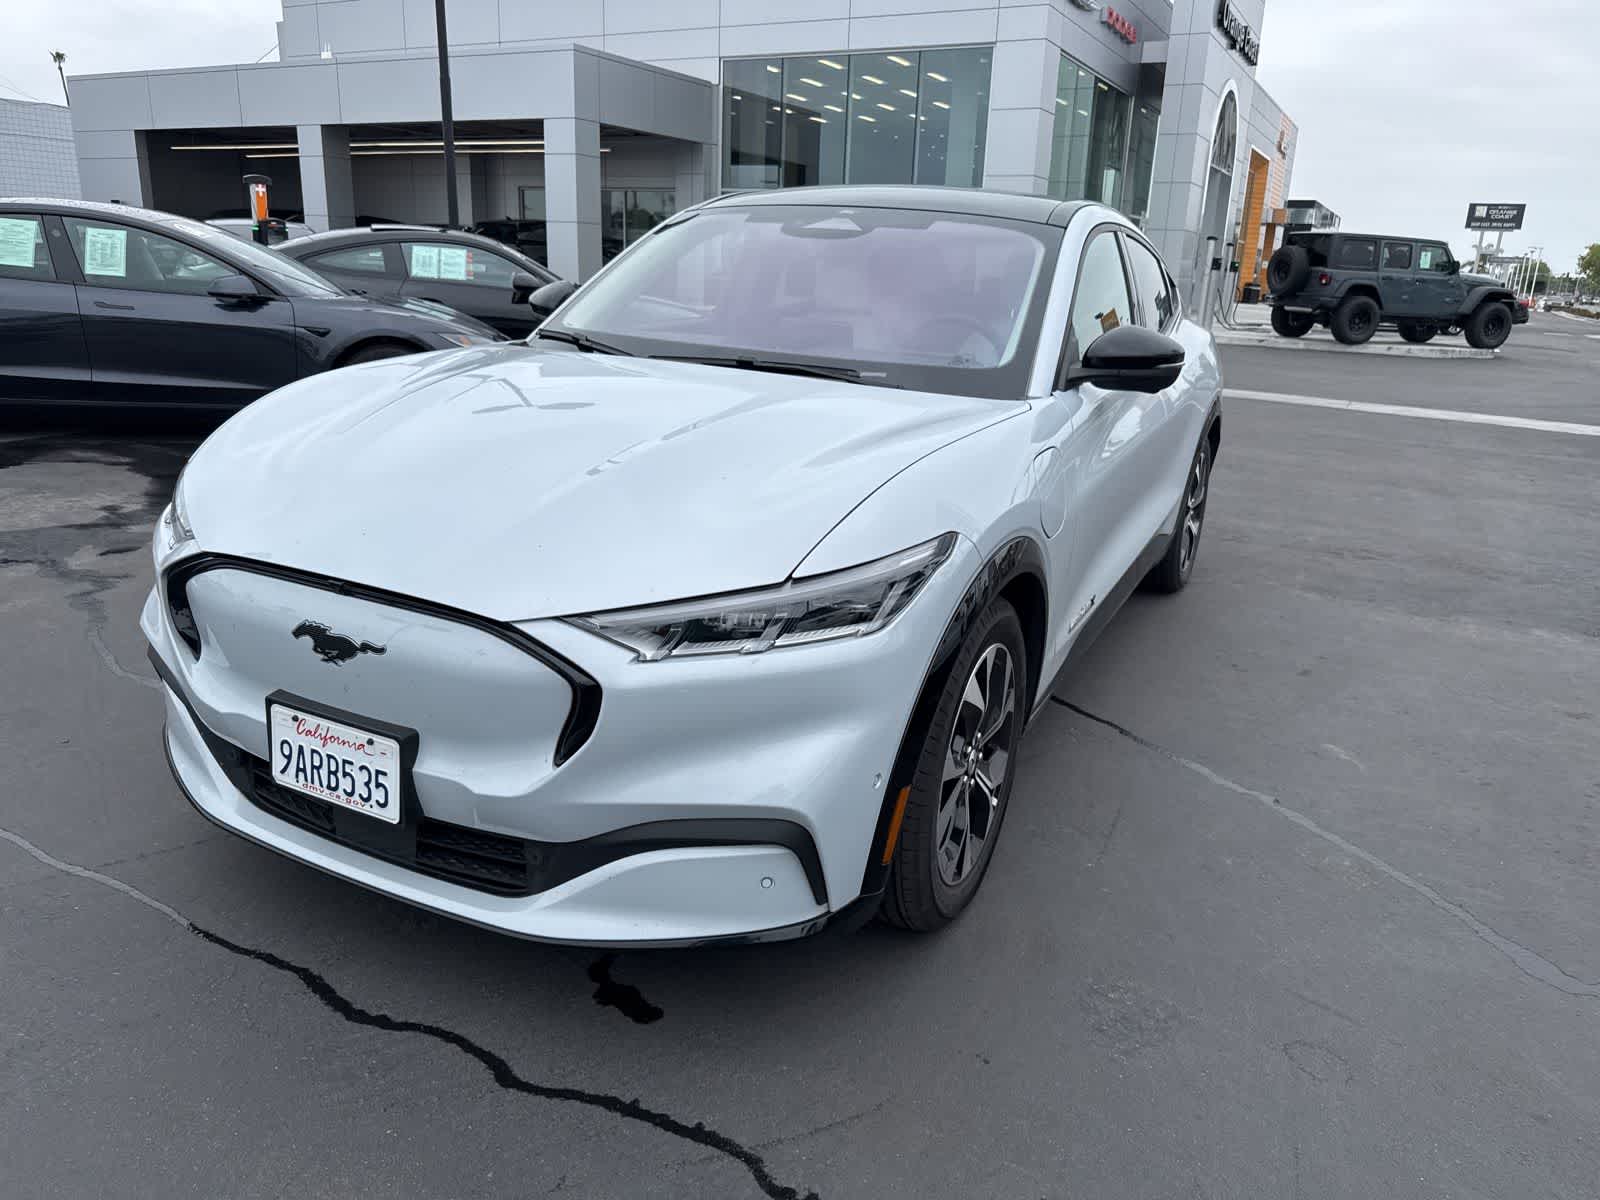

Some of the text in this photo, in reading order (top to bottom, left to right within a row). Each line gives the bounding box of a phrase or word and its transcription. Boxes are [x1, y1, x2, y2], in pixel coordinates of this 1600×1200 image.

[296, 718, 374, 757] California
[279, 739, 389, 809] 9ARB535
[302, 783, 366, 808] dmv.ca.gov
